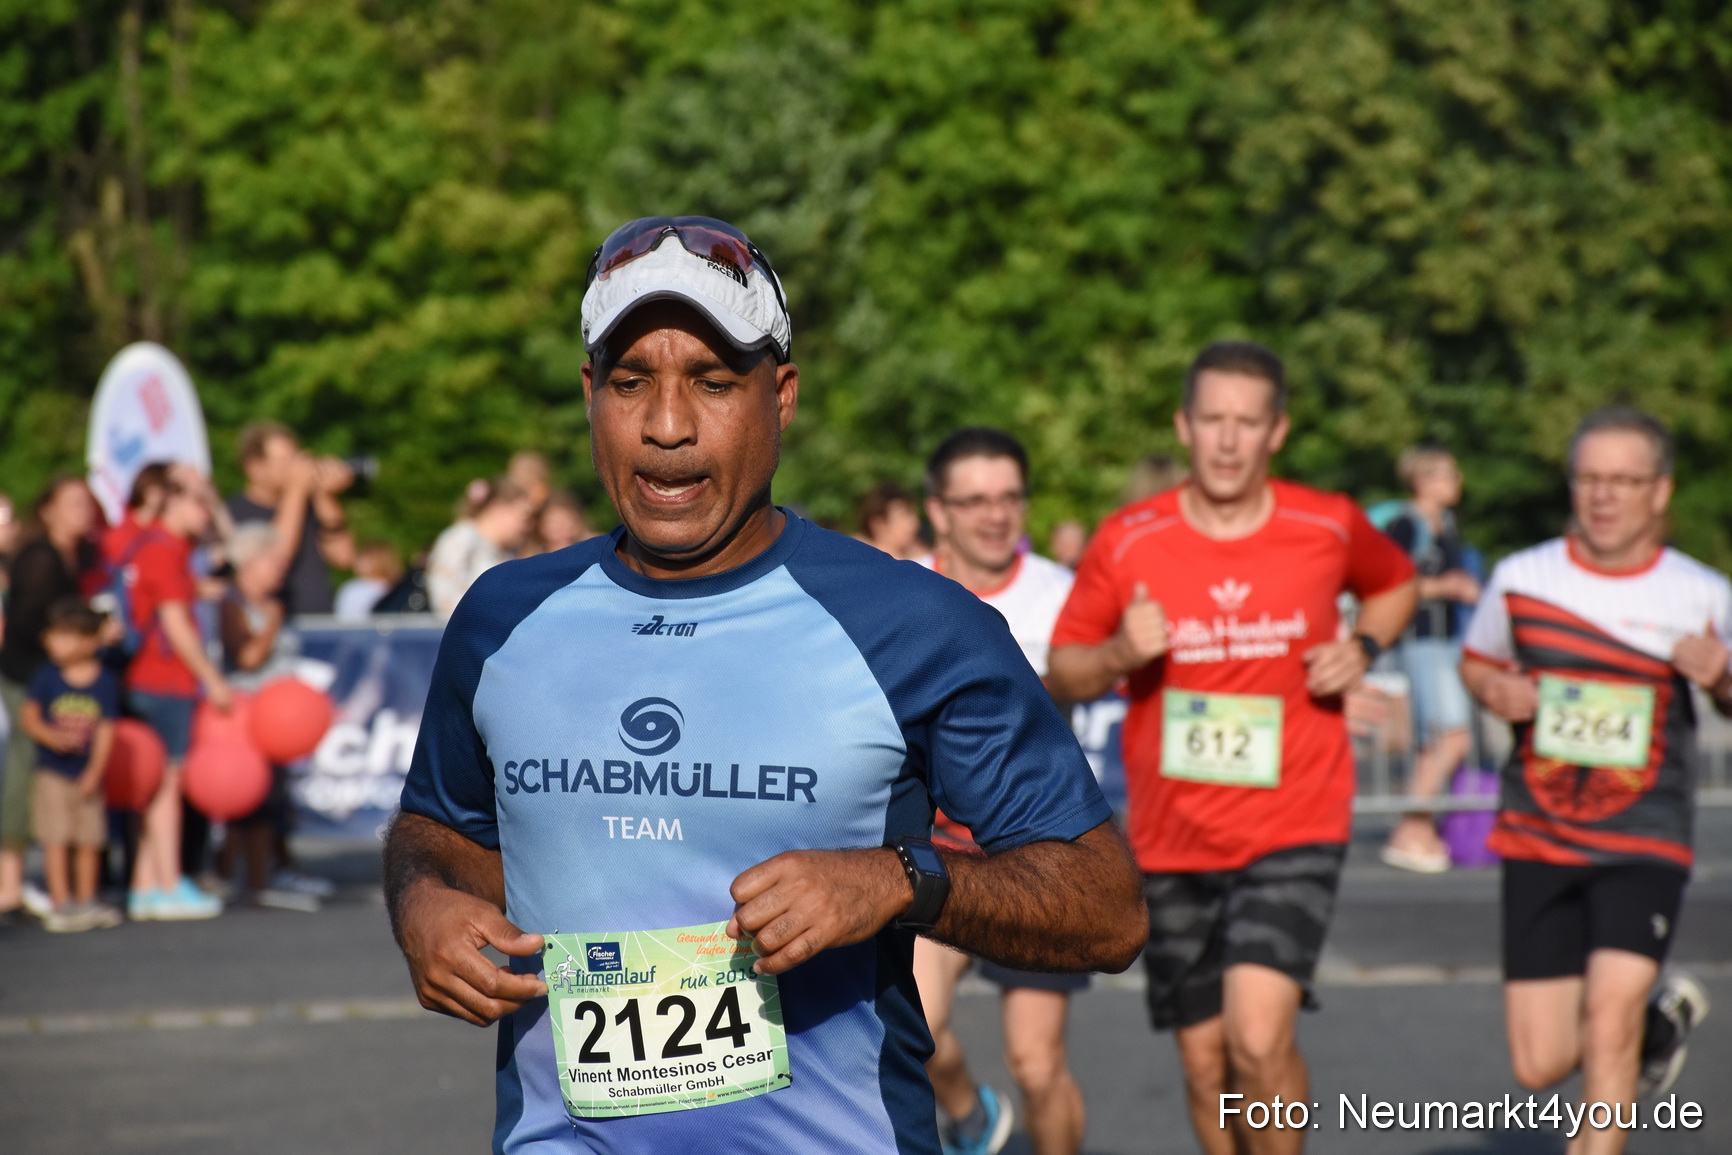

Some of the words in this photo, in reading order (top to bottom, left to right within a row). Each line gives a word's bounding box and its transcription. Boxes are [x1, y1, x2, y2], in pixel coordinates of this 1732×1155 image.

[707, 261, 733, 278] FACE
[1552, 707, 1633, 744] 2264
[1185, 722, 1252, 760] 612
[504, 758, 818, 802] SCHABMÜLLER
[602, 816, 683, 840] TEAM
[676, 931, 719, 943] Gesunde
[592, 950, 615, 958] Fischer
[696, 944, 726, 957] laufen
[576, 965, 657, 987] firmenlauf
[680, 974, 708, 990] run
[577, 986, 610, 994] neumarkt
[574, 986, 751, 1064] 2124
[568, 1068, 612, 1084] Vinent
[617, 1060, 717, 1083] Montesinos
[722, 1049, 774, 1069] Cesar
[608, 1083, 682, 1098] Schabmüller
[686, 1075, 725, 1091] GmbH
